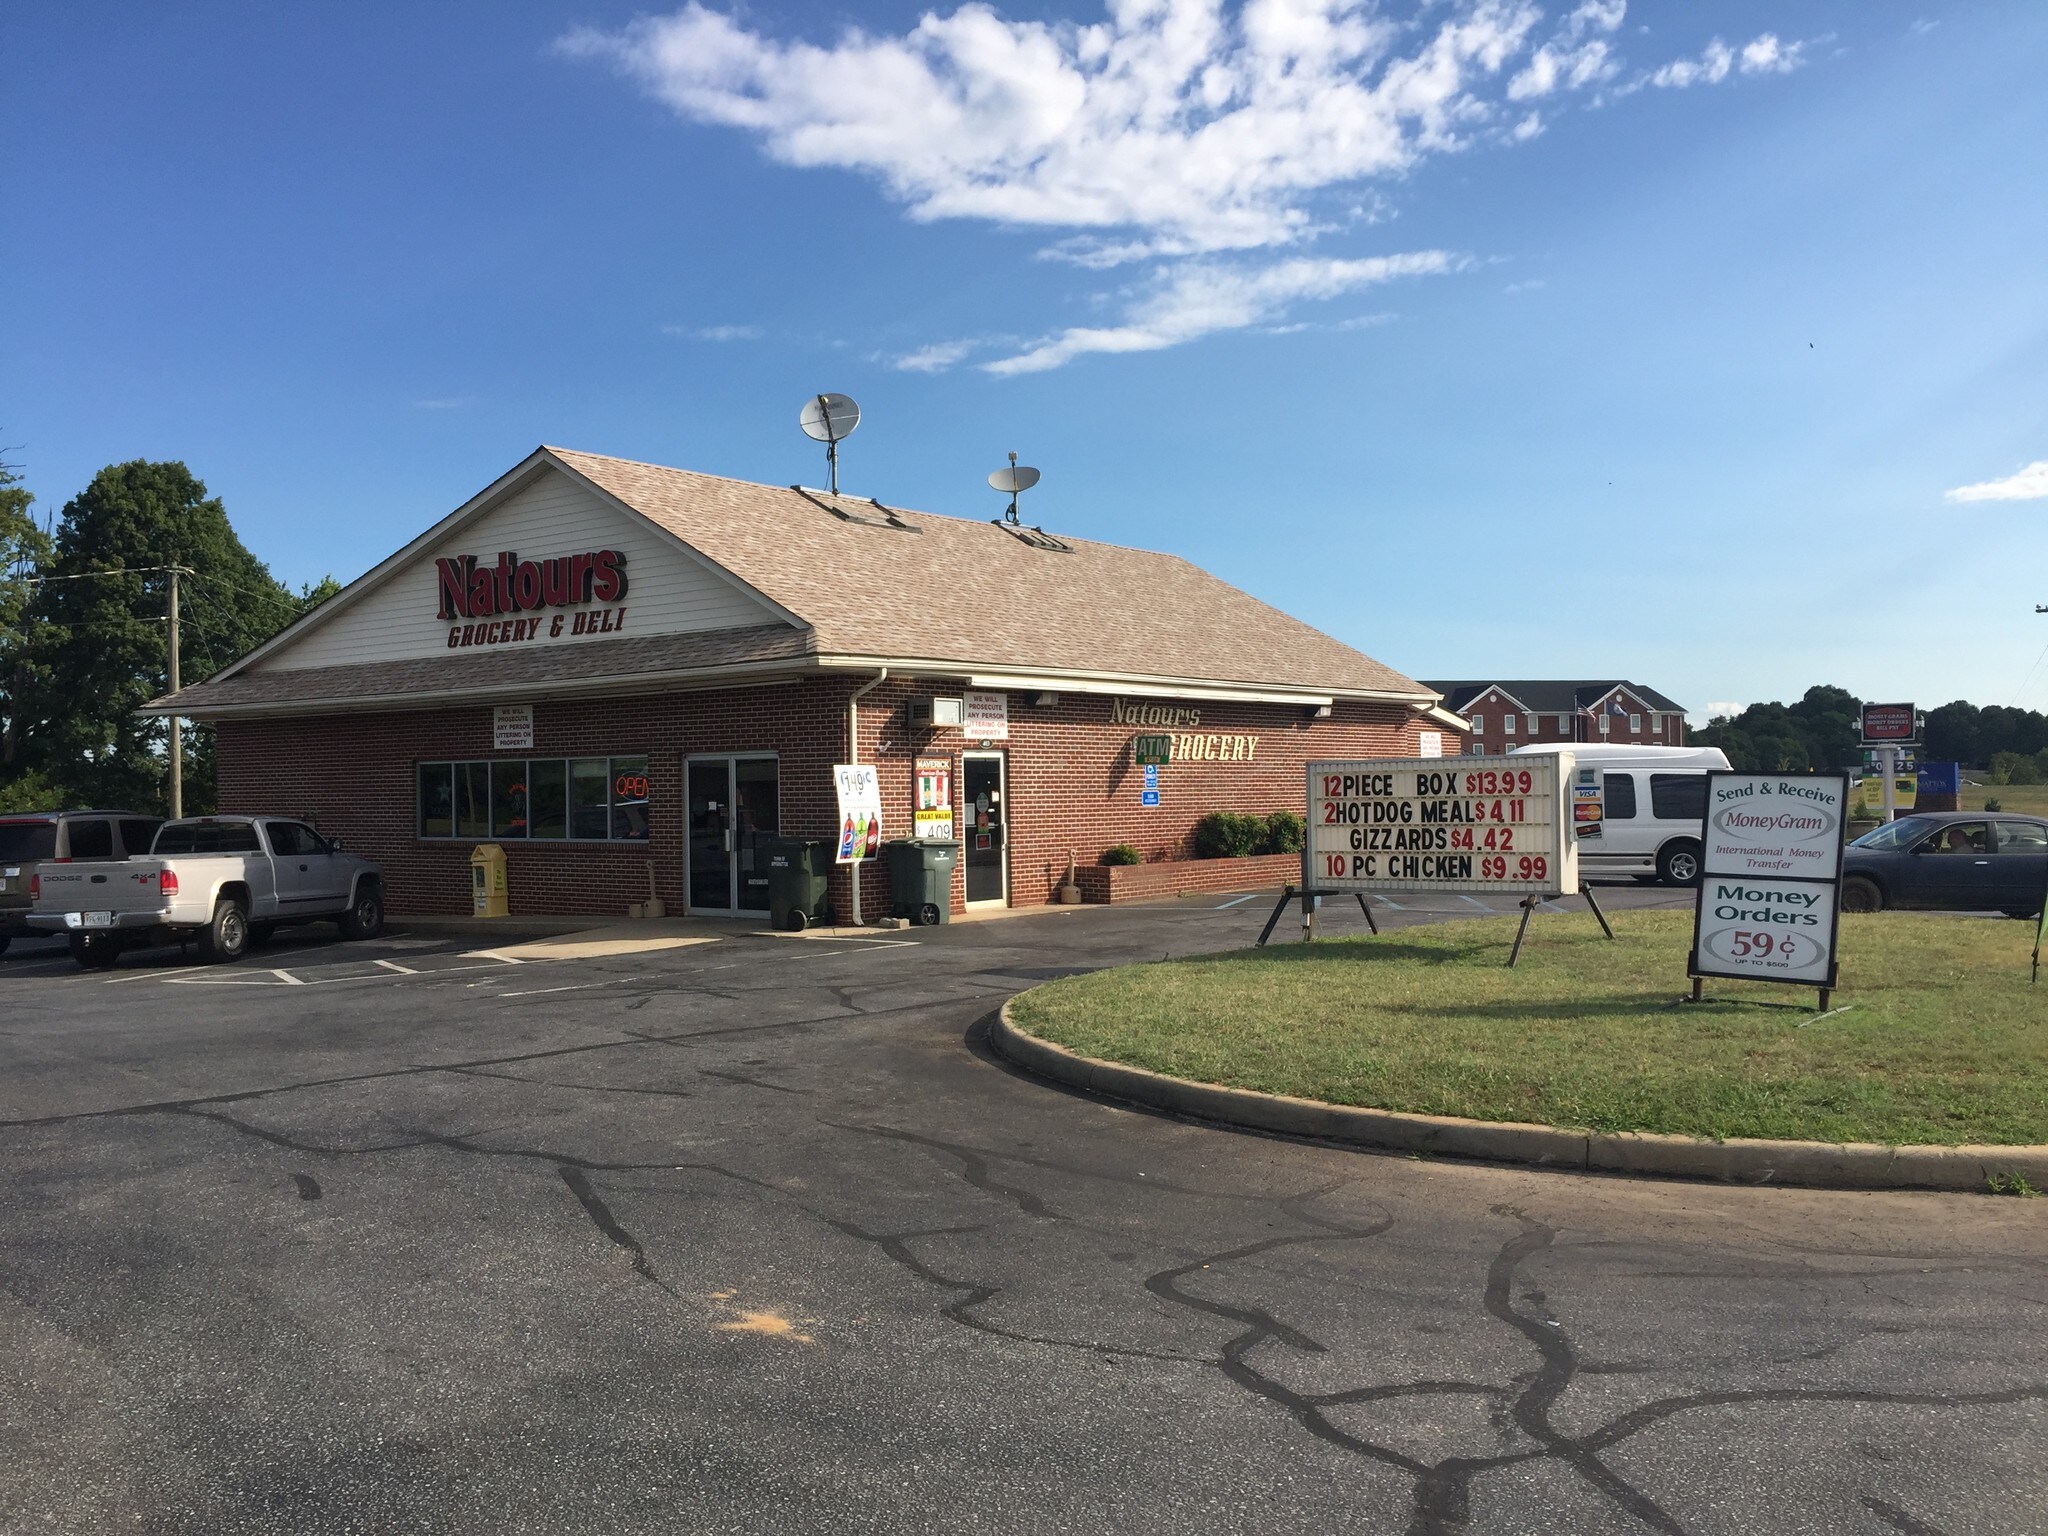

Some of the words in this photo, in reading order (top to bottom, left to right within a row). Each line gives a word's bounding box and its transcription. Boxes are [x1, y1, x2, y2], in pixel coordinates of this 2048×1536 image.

[435, 550, 628, 619] Natours
[448, 617, 542, 648] GROCERY
[550, 614, 565, 638] &
[571, 607, 627, 635] DELI
[1109, 697, 1201, 726] Natour's
[1137, 738, 1169, 756] ATM
[916, 760, 950, 768] MAVERICK
[617, 776, 649, 796] OPEN
[1417, 773, 1457, 796] BOX
[1466, 771, 1532, 795] $13.99
[1717, 783, 1753, 802] Send
[1760, 782, 1772, 795] &
[1778, 782, 1835, 805] Receive
[1725, 812, 1823, 831] MoneyGram
[1350, 828, 1447, 850] GIZZARDS
[1451, 828, 1513, 851] $4.42
[1716, 845, 1784, 857] International
[1789, 848, 1824, 859] Money
[1326, 855, 1346, 877] 10
[1353, 856, 1376, 877] PC
[1389, 855, 1472, 879] CHICKEN
[1482, 856, 1547, 880] $9.99
[1747, 858, 1794, 870] Transfer
[1717, 885, 1821, 908] Money
[1715, 905, 1818, 926] Orders
